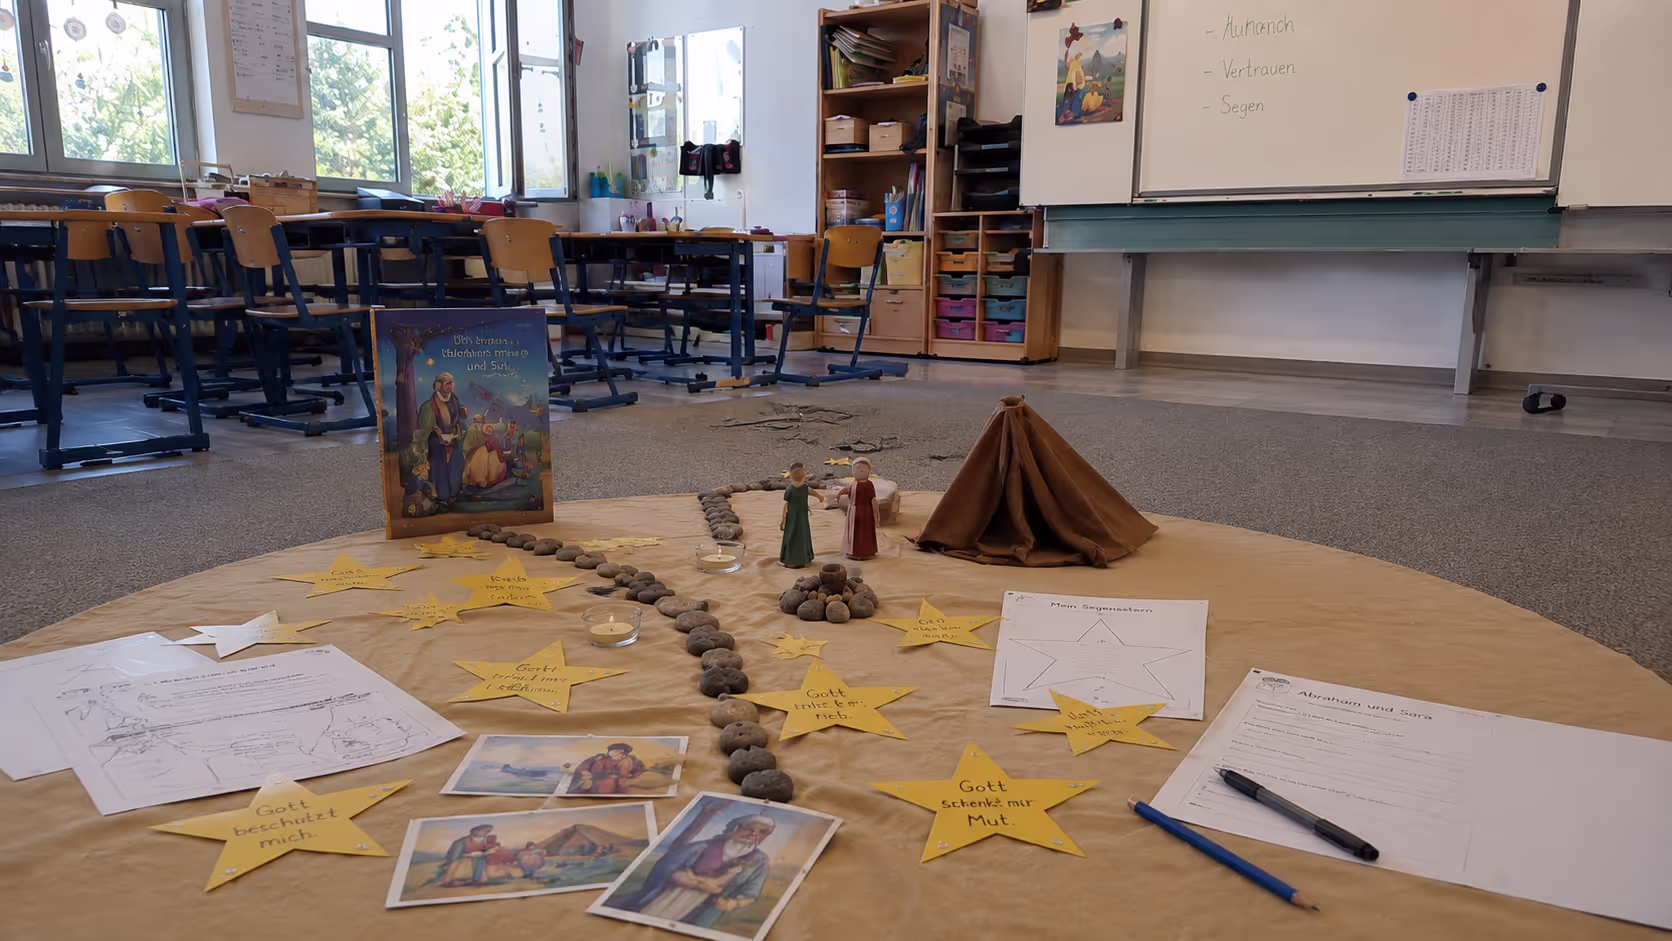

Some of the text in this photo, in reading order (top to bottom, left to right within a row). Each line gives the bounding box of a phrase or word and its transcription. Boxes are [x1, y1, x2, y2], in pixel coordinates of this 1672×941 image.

[1222, 58, 1296, 80] Vertrauen
[1220, 94, 1265, 119] Segen
[467, 360, 487, 371] und
[806, 688, 847, 699] Gott
[1297, 690, 1361, 707] Abraham
[1367, 704, 1394, 713] und
[1399, 709, 1433, 720] Sara
[959, 779, 1008, 793] Gott
[255, 799, 311, 817] Gott
[1007, 799, 1036, 808] mir
[967, 813, 1016, 828] Mut.
